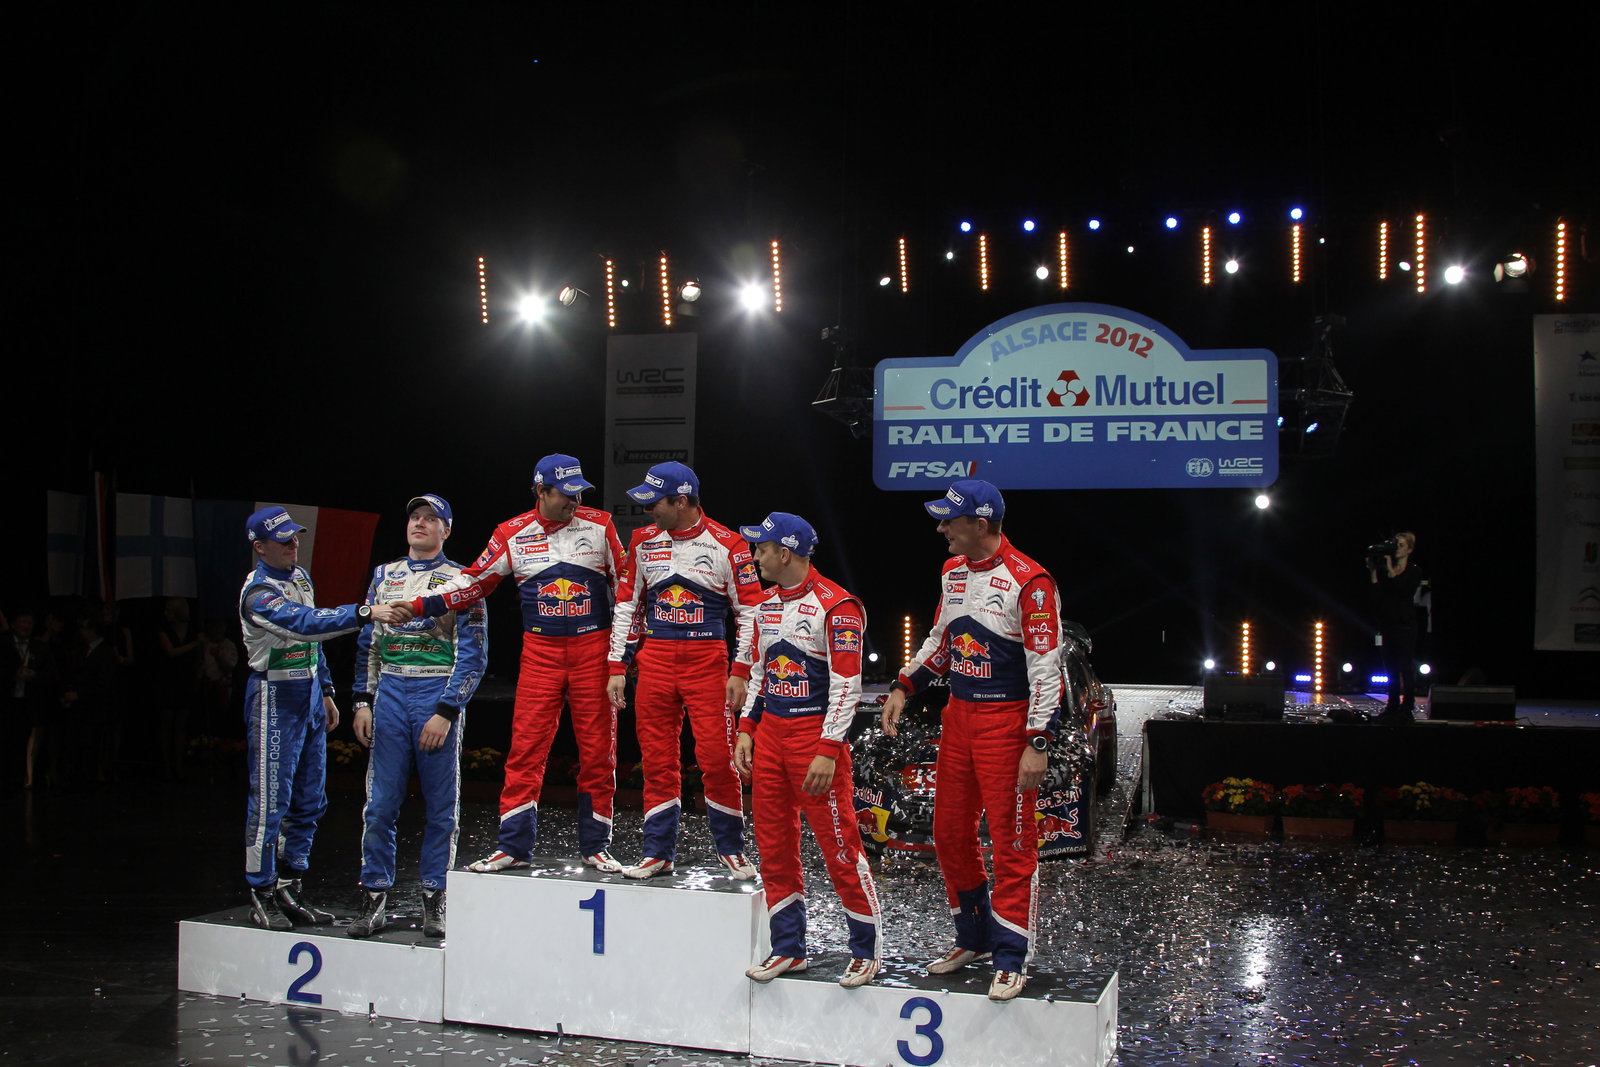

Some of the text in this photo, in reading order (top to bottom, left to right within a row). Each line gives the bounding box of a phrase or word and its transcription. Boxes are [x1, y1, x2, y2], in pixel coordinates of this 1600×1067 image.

[990, 321, 1153, 361] ALSACE 2012
[617, 368, 684, 384] WRC
[929, 372, 1223, 410] Crédit Mutuel
[888, 420, 1263, 446] RALLYE DE FRANCE
[1218, 457, 1263, 467] WRC
[538, 599, 591, 616] Red Bull
[654, 604, 676, 623] Red
[676, 607, 704, 623] Bull
[403, 643, 442, 653] EDGE
[963, 660, 992, 680] Bull
[782, 681, 809, 698] Bull
[270, 686, 281, 813] Powered by FORD EcoBoost
[828, 789, 844, 848] CITROËN
[580, 889, 605, 954] 1
[287, 942, 322, 1004] 2
[897, 997, 944, 1067] 3
